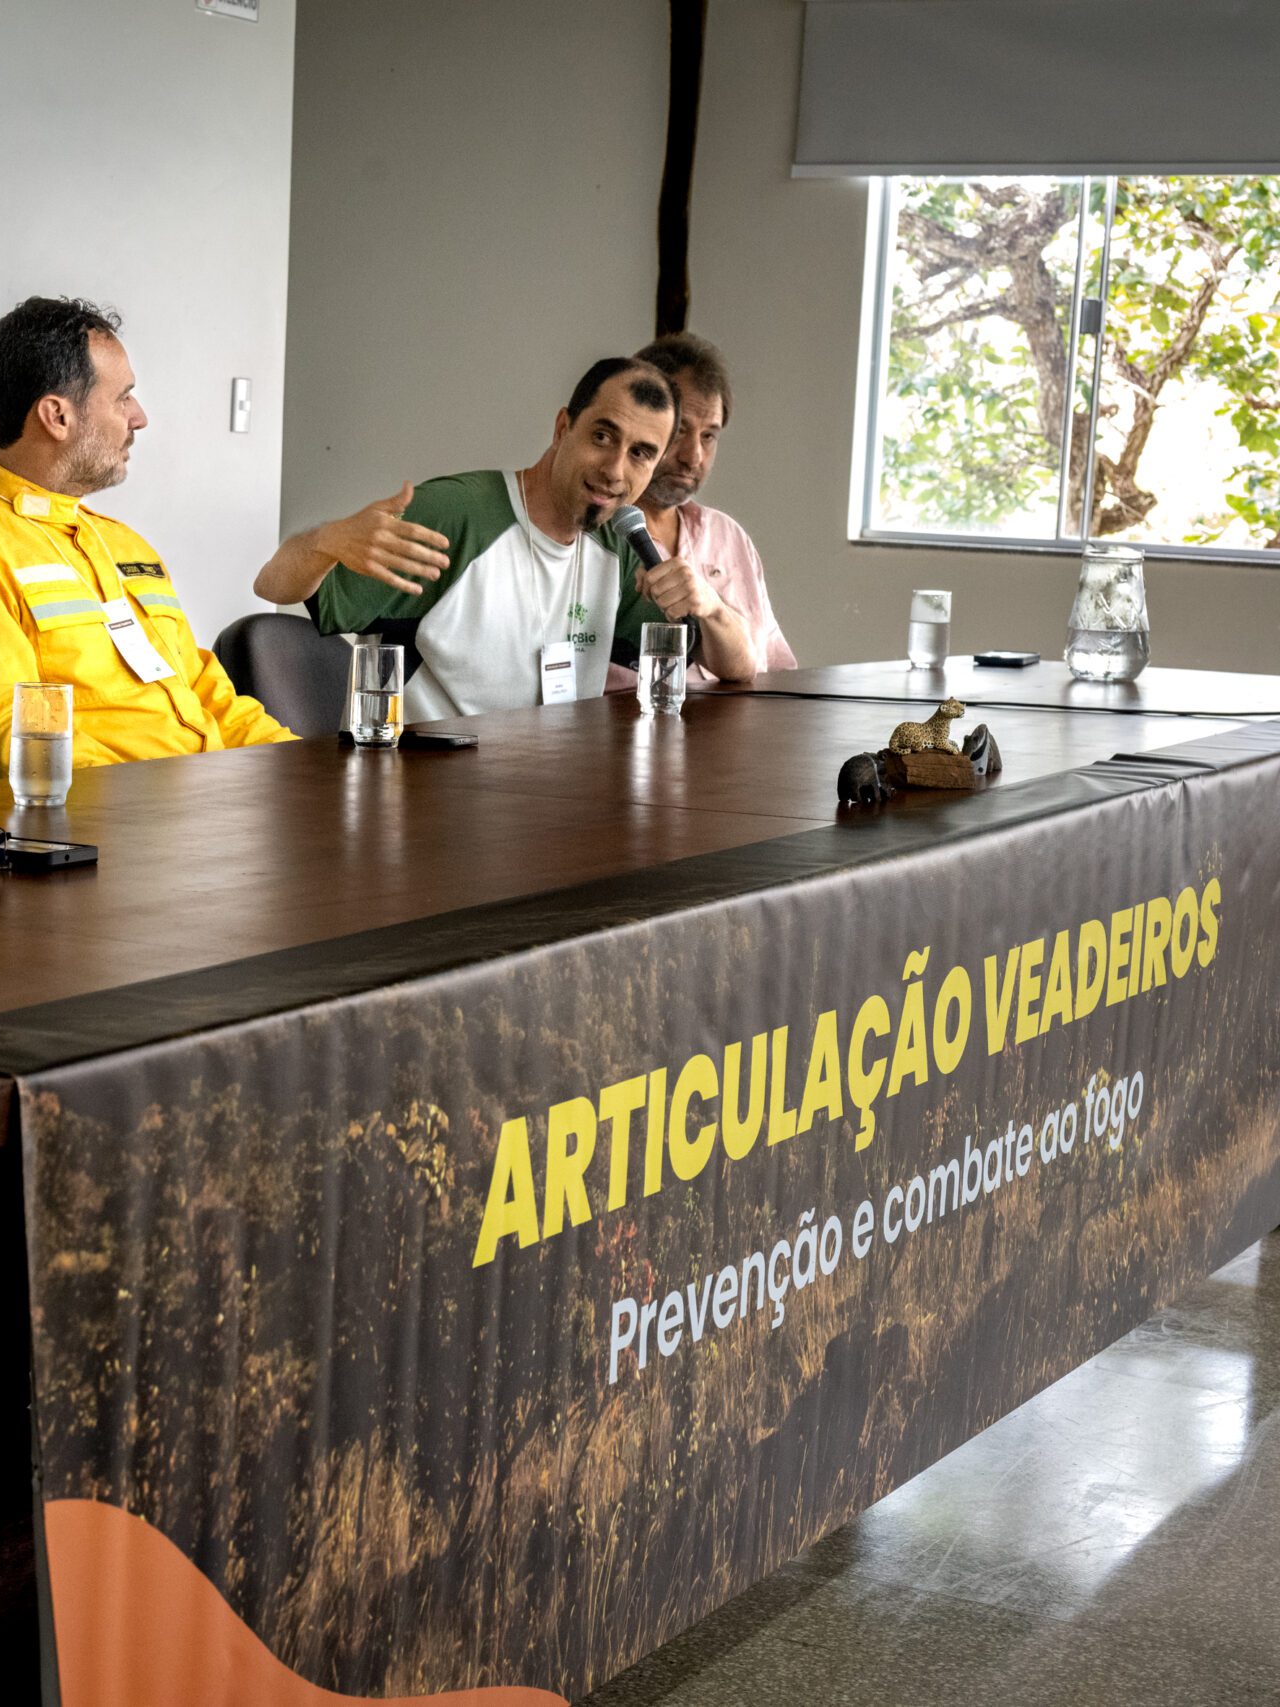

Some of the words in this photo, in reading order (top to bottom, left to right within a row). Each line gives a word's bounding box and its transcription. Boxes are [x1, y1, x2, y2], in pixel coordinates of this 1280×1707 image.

[472, 946, 972, 1268] ARTICULAÇÃO
[984, 878, 1221, 1057] VEADEIROS
[608, 1207, 842, 1385] Prevenção
[852, 1200, 875, 1259] e
[883, 1119, 1033, 1244] combate
[1040, 1101, 1078, 1165] ao
[1084, 1071, 1144, 1151] fogo
